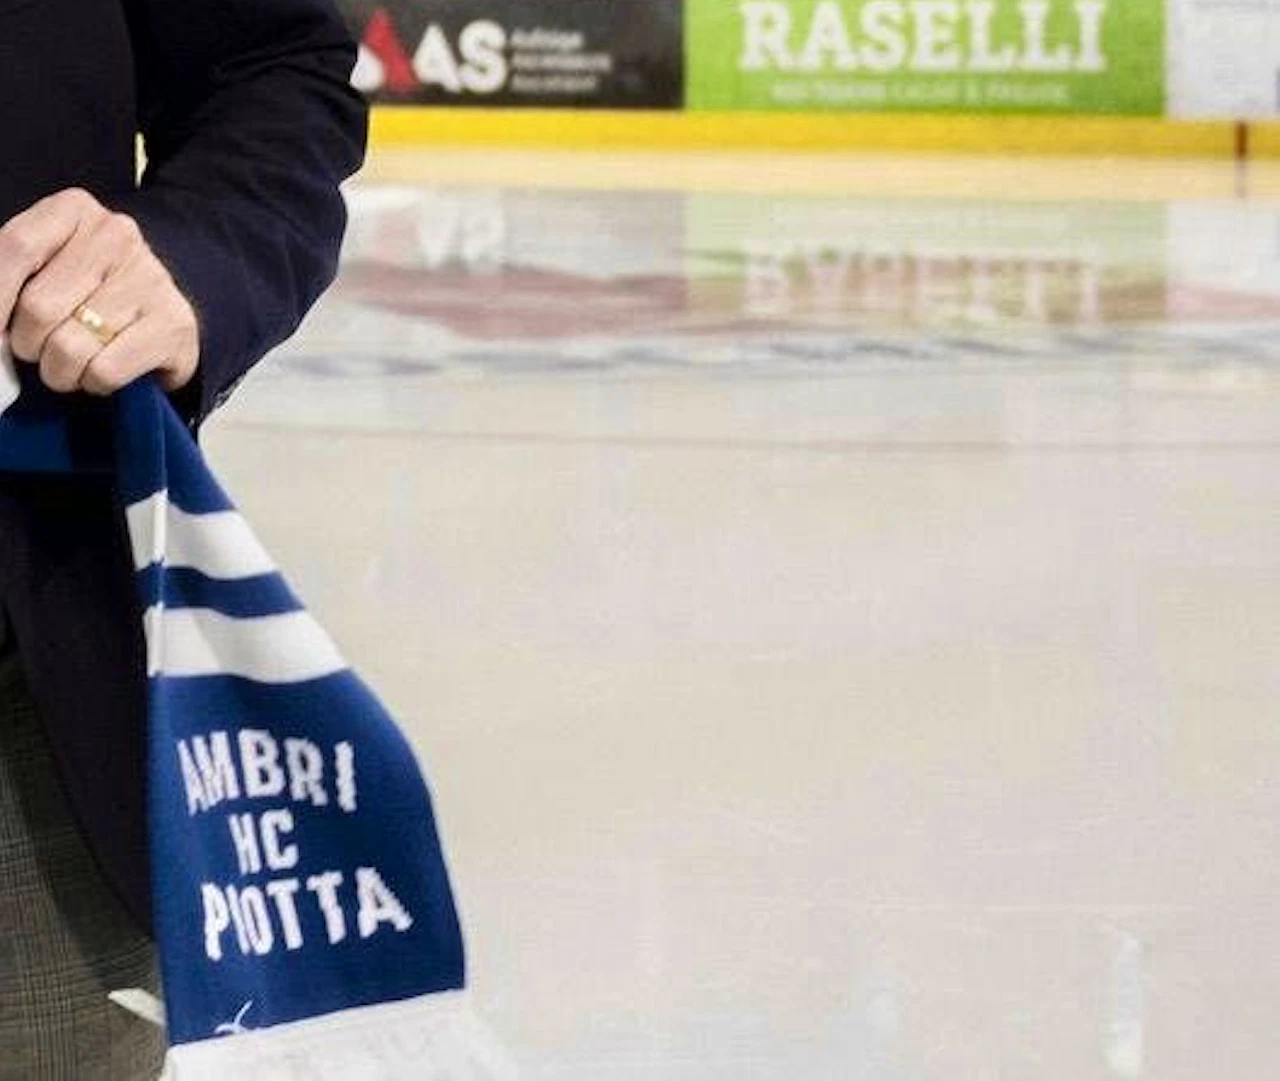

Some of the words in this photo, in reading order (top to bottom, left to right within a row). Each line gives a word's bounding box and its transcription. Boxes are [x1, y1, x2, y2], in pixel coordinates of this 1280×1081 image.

[177, 729, 357, 816] AMBRI
[228, 809, 299, 875] HC
[201, 867, 413, 961] PIOTTA
